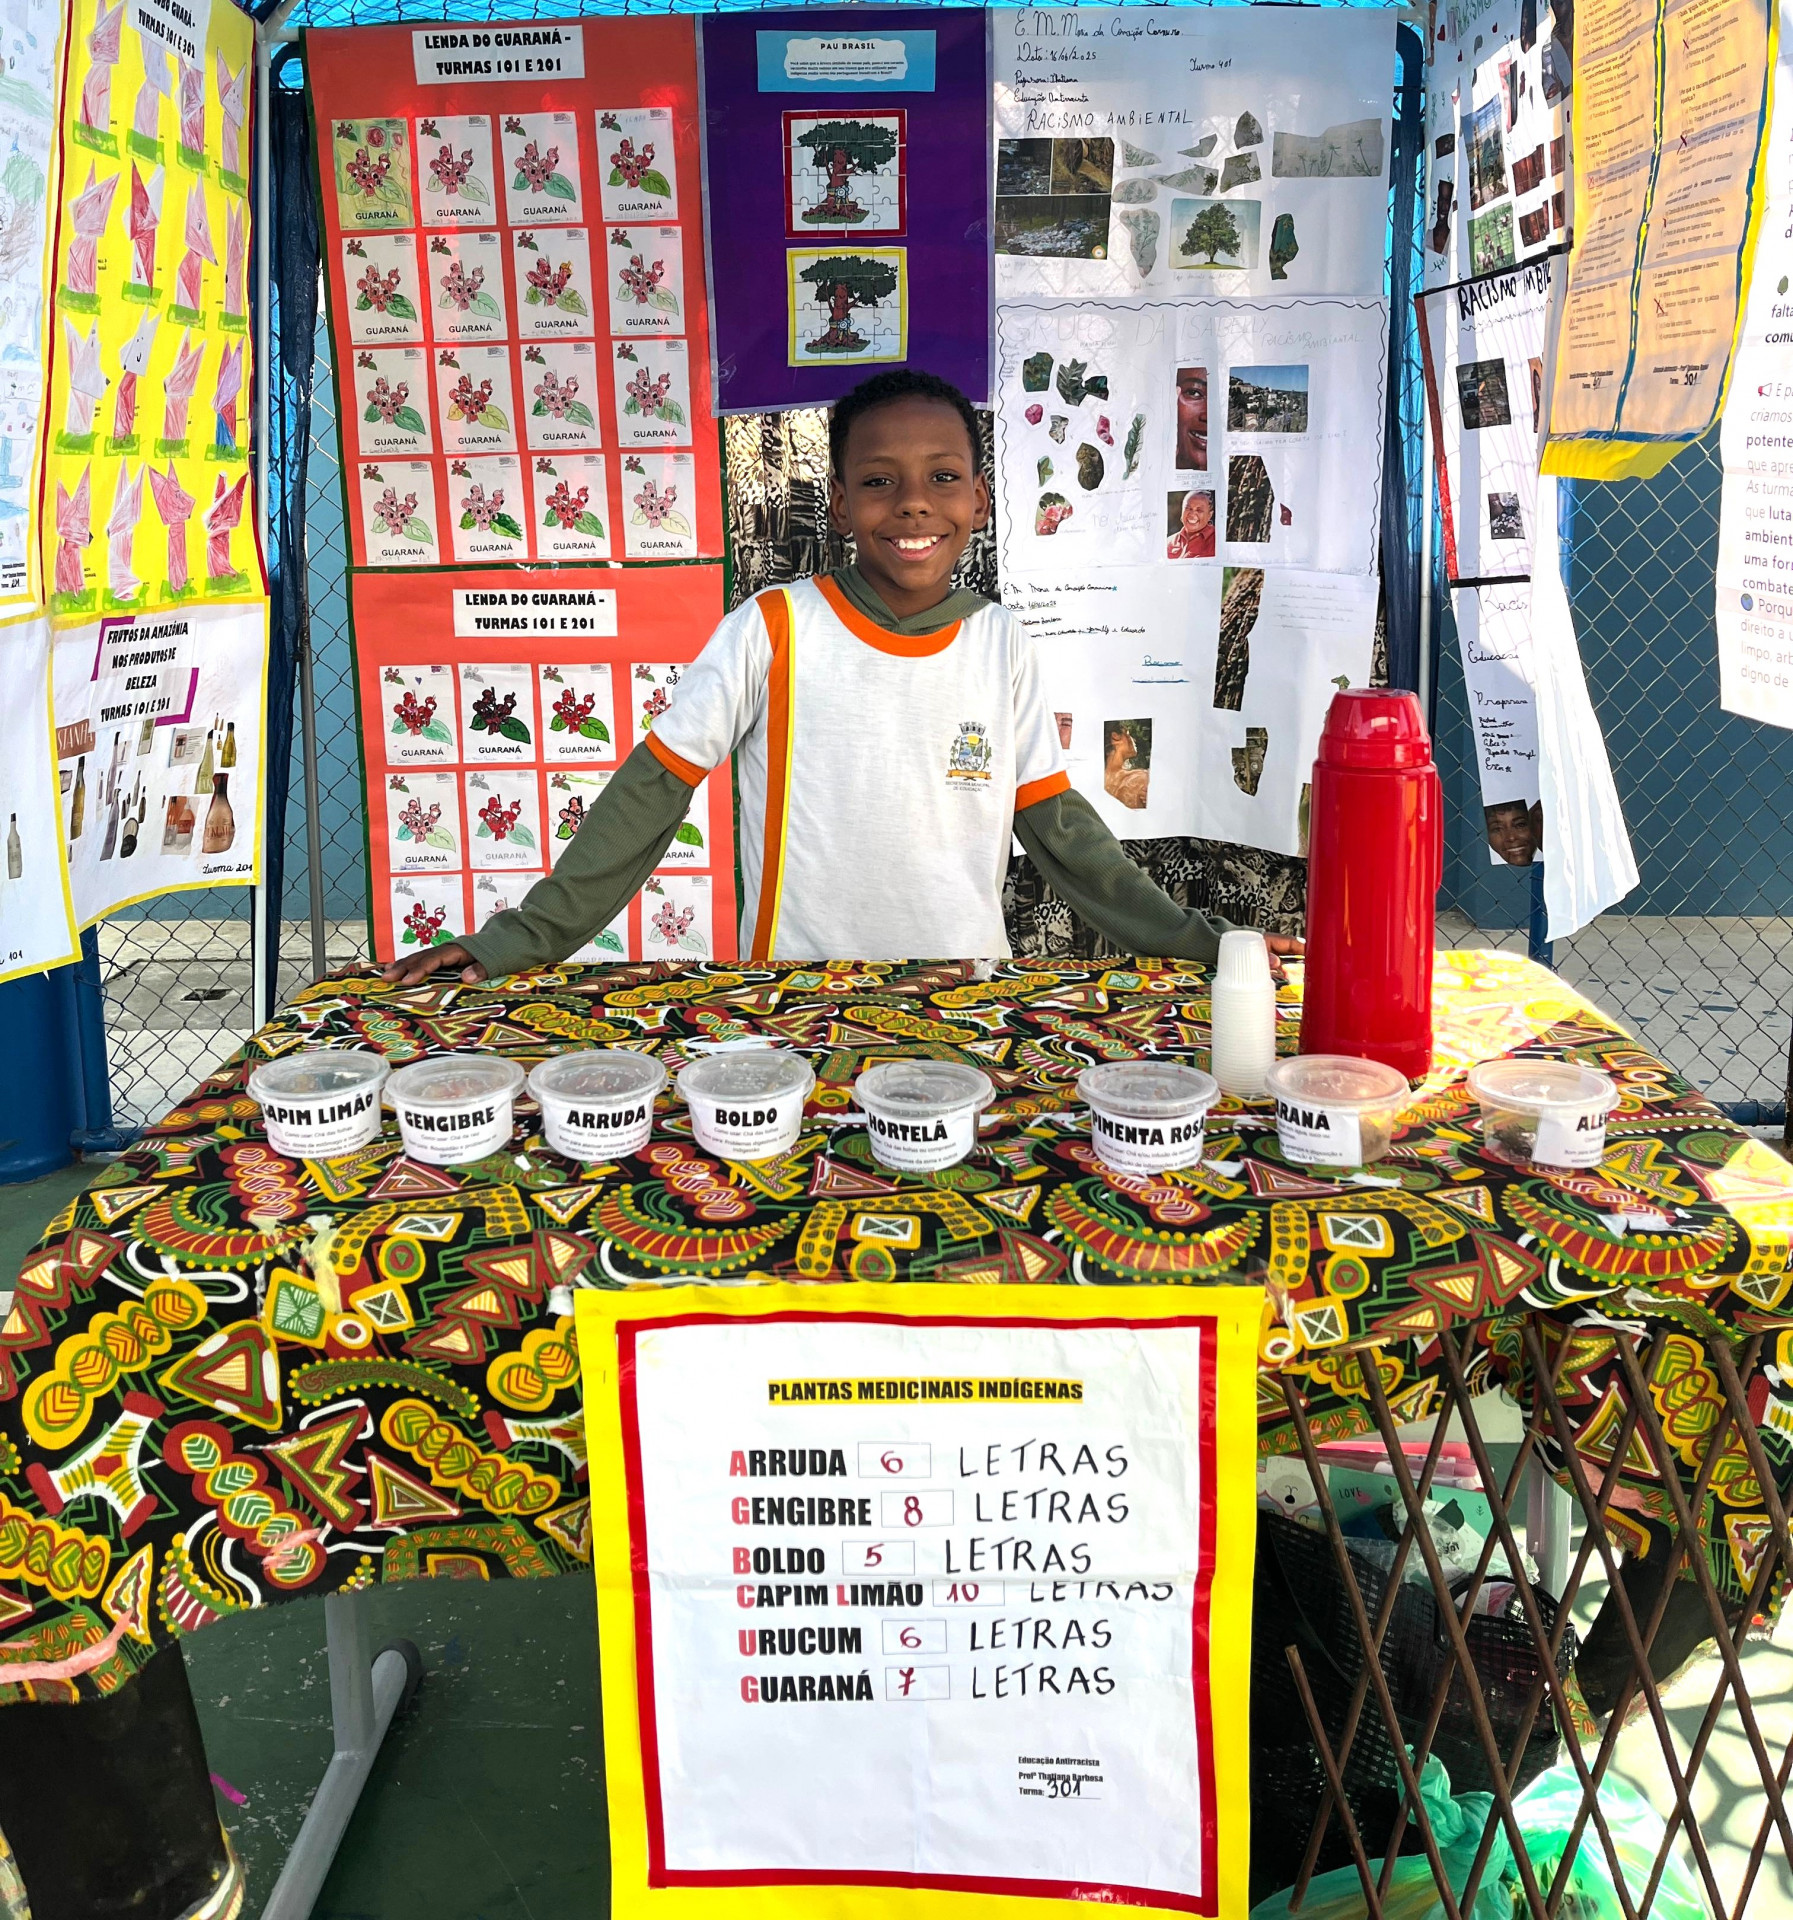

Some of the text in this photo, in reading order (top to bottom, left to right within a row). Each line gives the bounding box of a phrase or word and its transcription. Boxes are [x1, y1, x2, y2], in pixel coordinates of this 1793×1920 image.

[139, 8, 165, 38] TURMAS
[183, 39, 195, 58] 302
[1092, 24, 1104, 37] da
[425, 28, 560, 50] LENDA DO GUARANÁ
[842, 42, 876, 50] BRASIL
[436, 58, 562, 76] TURMAS 101 E 201
[436, 206, 481, 217] GUARANÁ
[523, 204, 568, 215] GUARANÁ
[618, 200, 663, 211] GUARANÁ
[355, 210, 399, 220] GUARANÁ
[448, 324, 492, 334] GUARANÁ
[534, 319, 579, 329] GUARANÁ
[625, 317, 670, 327] GUARANÁ
[365, 325, 409, 335] GUARANÁ
[1750, 408, 1793, 423] criamos
[457, 434, 502, 446] GUARANÁ
[542, 431, 586, 441] GUARANÁ
[633, 428, 677, 439] GUARANÁ
[374, 436, 417, 446] GUARANÁ
[1746, 435, 1793, 449] potente
[1747, 460, 1767, 474] que
[1746, 480, 1761, 494] As
[1745, 506, 1792, 521] que luta
[470, 542, 513, 553] GUARANÁ
[553, 541, 596, 551] GUARANÁ
[640, 539, 683, 550] GUARANÁ
[381, 548, 425, 558] GUARANÁ
[1744, 554, 1793, 570] uma for
[1742, 578, 1793, 596] combate
[465, 591, 596, 606] LENDA DO GUARANÁ
[475, 617, 595, 630] TURMAS 101 E 201
[1741, 619, 1785, 640] direito a
[107, 621, 189, 645] FRUTOS DA AMAZÔNIA
[112, 647, 177, 669] NOS PRODUTOS DE
[1741, 641, 1772, 662] limpo,
[125, 675, 157, 691] BELEZA
[1741, 665, 1789, 688] digno de
[101, 703, 132, 723] TURMAS
[134, 702, 150, 716] 101
[401, 748, 444, 758] GUARANÁ
[478, 745, 522, 755] GUARANÁ
[559, 745, 602, 755] GUARANÁ
[405, 854, 448, 864] GUARANÁ
[485, 851, 528, 861] GUARANÁ
[664, 851, 695, 859] ARANÁ
[9, 949, 23, 961] 101
[318, 1093, 374, 1125] LIMÃO
[404, 1106, 495, 1132] GENGIBRE
[566, 1104, 646, 1129] ARRUDA
[715, 1107, 778, 1127] BOLDO
[868, 1112, 948, 1142] HORTELÃ
[1091, 1109, 1205, 1145] PIMENTA ROSA
[768, 1378, 1084, 1402] PLANTAS MEDICINAIS INDÍGENAS
[729, 1439, 1129, 1479] ARRUDA 6 LETRAS
[1338, 1487, 1362, 1500] LOVE
[731, 1489, 1130, 1527] GENGIBRE 8 LETRAS
[732, 1536, 1092, 1575] BOLDO 5 LETRAS
[737, 1580, 1174, 1609] CAPIM LIMÃO 10 LETRAS
[738, 1617, 1113, 1658] URUCUM 6 LETRAS
[741, 1663, 1116, 1704] GUARANÁ 7 LETRAS
[1018, 1756, 1100, 1767] Educação Antirracista
[1038, 1772, 1071, 1782] Thatiana
[1072, 1773, 1104, 1783] Barbosa
[1019, 1776, 1081, 1799] Turma: 301
